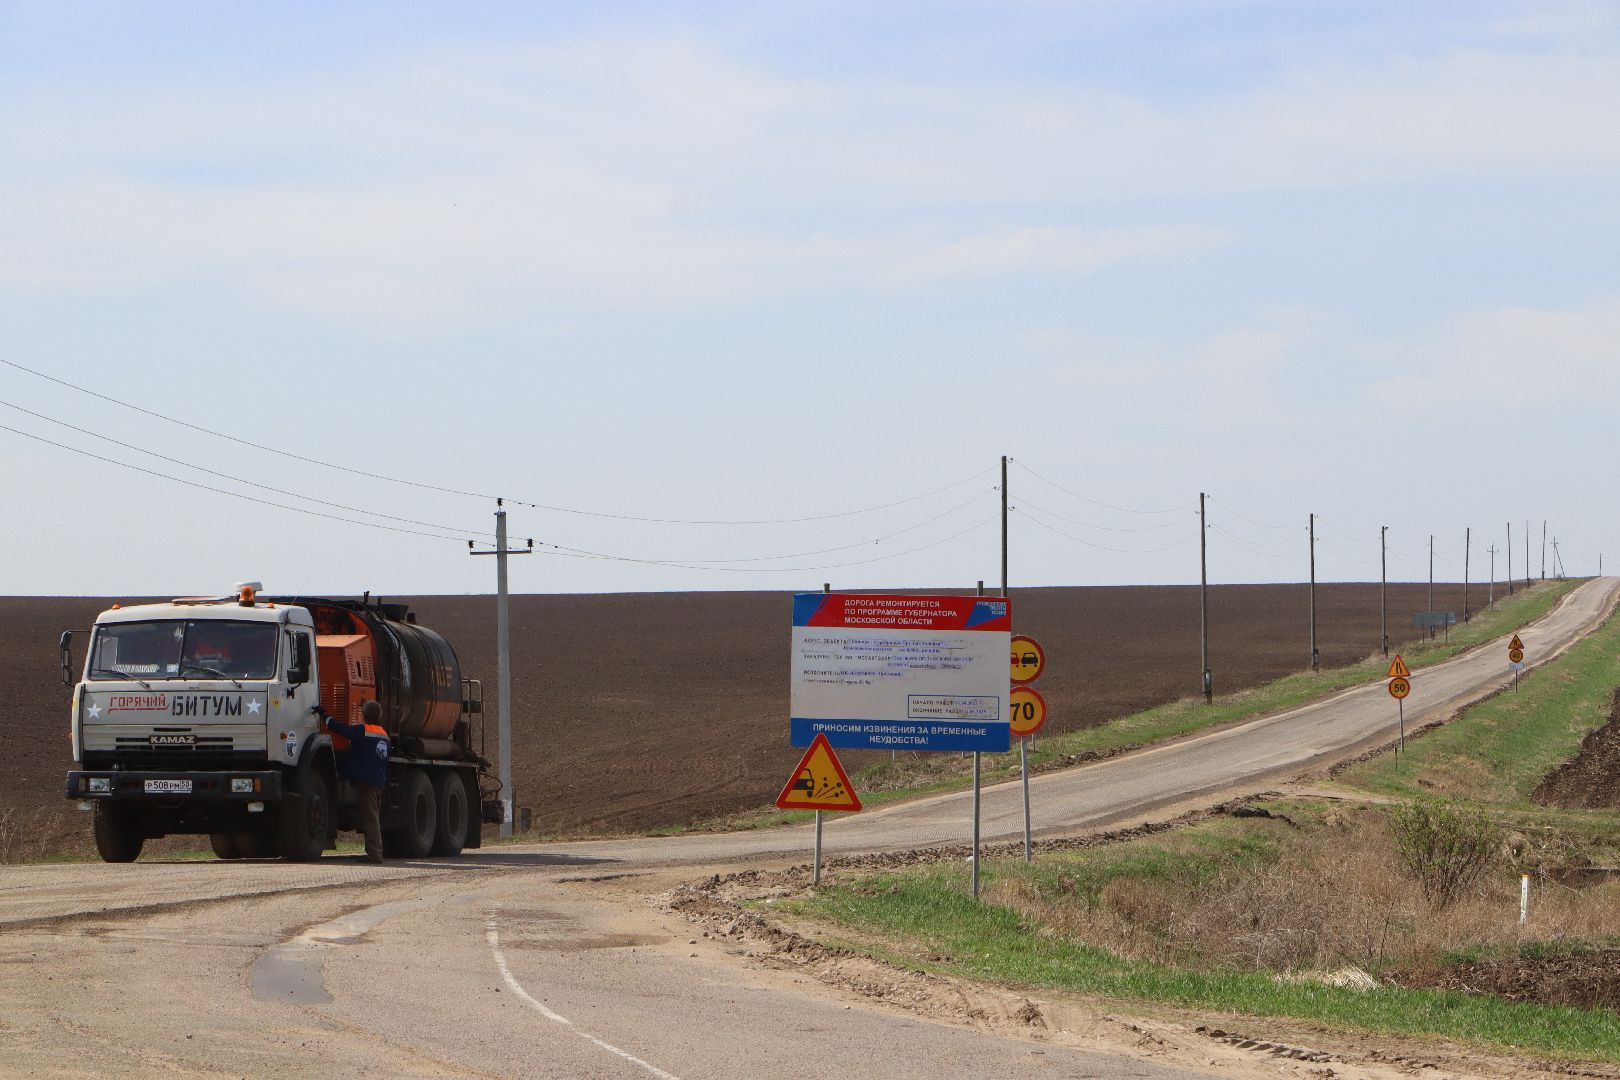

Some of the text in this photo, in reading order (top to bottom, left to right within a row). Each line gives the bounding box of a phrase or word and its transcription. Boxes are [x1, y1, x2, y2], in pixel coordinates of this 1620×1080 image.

[844, 599, 940, 608] ДОРОГА РЕМОНТИРУЕТСЯ
[857, 608, 903, 616] ПРОГРАММЕ
[904, 609, 958, 617] ГУБЕРНАТОРА
[844, 615, 933, 625] МОСКОВСКОЙ ОБЛАСТИ
[1394, 683, 1406, 692] 50
[109, 693, 243, 716] ГОРЯЧИЙ БИТУМ
[1010, 701, 1035, 722] 70
[812, 723, 987, 736] ПРИНОСИМ ИЗВИНЕНИЯ ЗА ВРЕМЕННЫЕ
[150, 736, 195, 744] KAMAZ
[869, 735, 929, 745] НЕУДОБСТВА!
